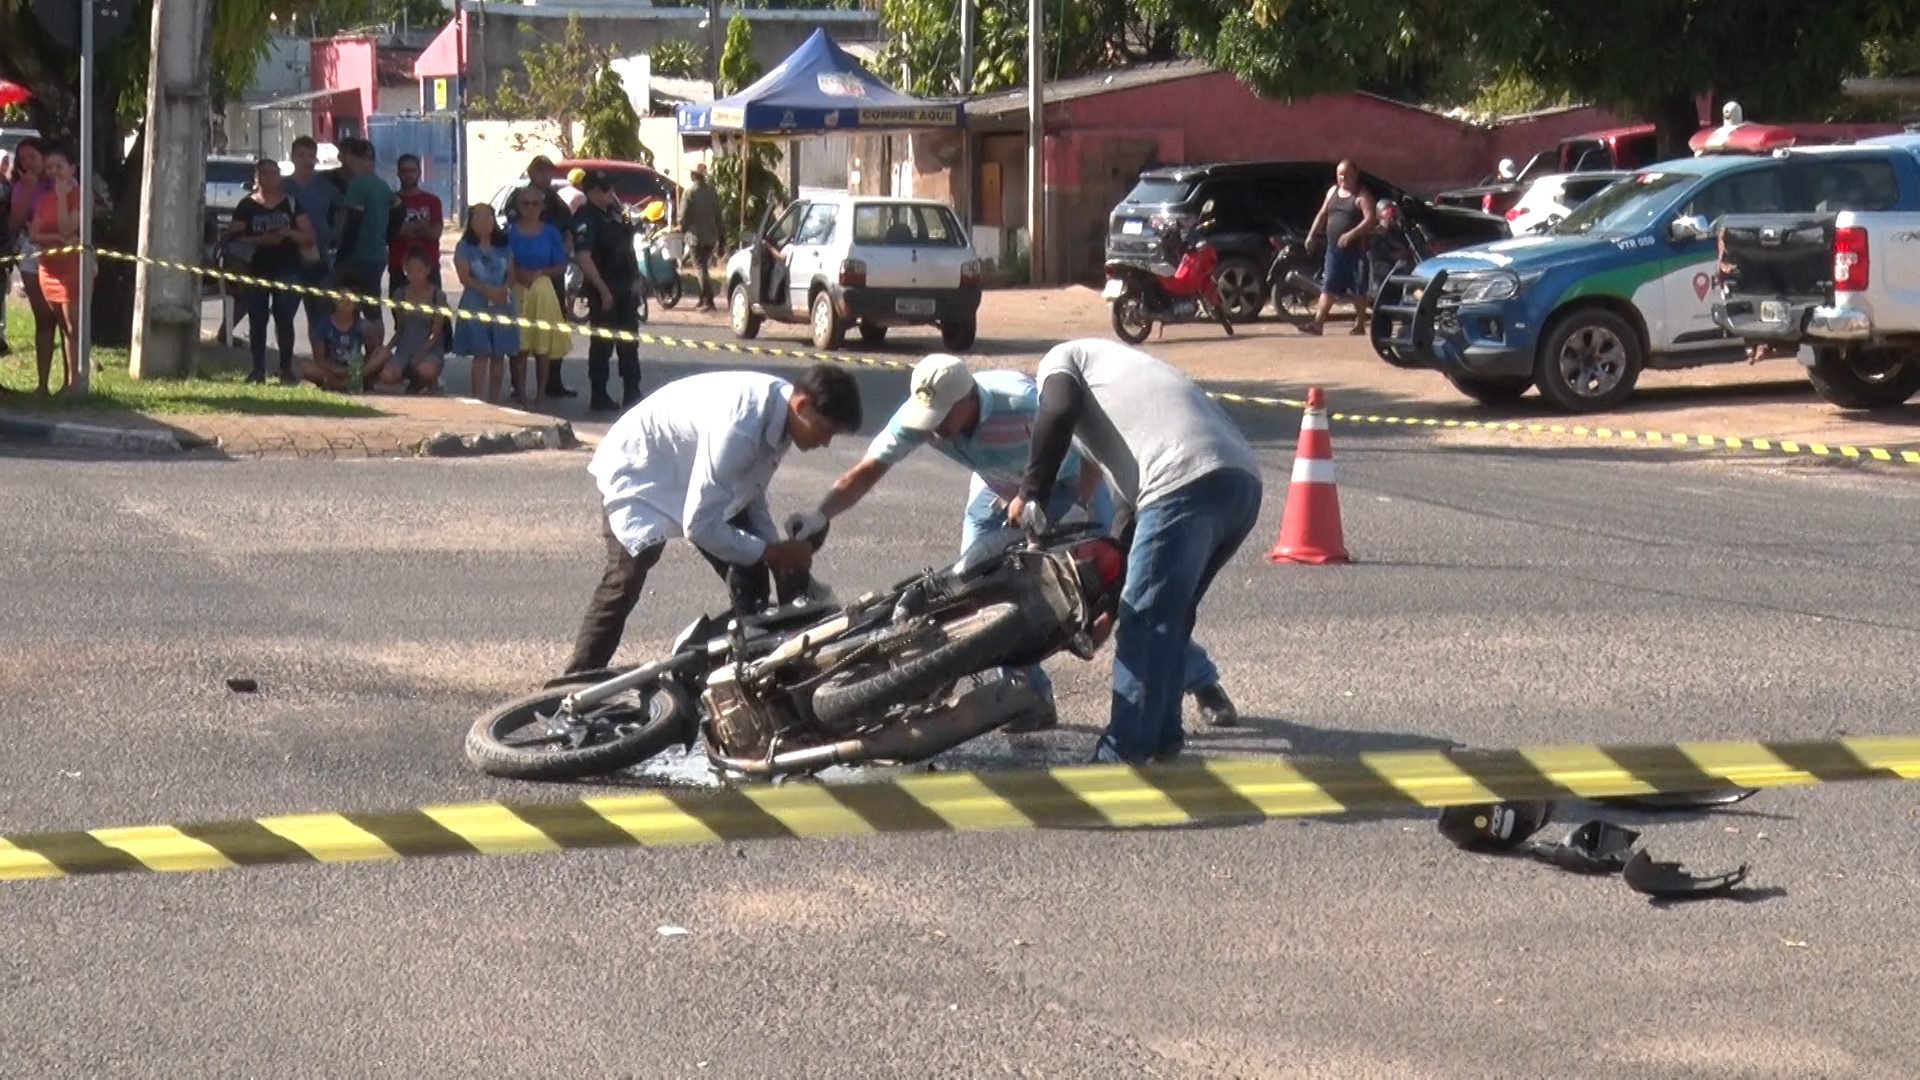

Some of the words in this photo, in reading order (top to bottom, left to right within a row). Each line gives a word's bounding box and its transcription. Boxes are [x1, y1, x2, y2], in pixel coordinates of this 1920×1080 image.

[862, 110, 916, 121] COMPRE
[919, 110, 953, 121] AQUI
[1617, 239, 1637, 250] VTR
